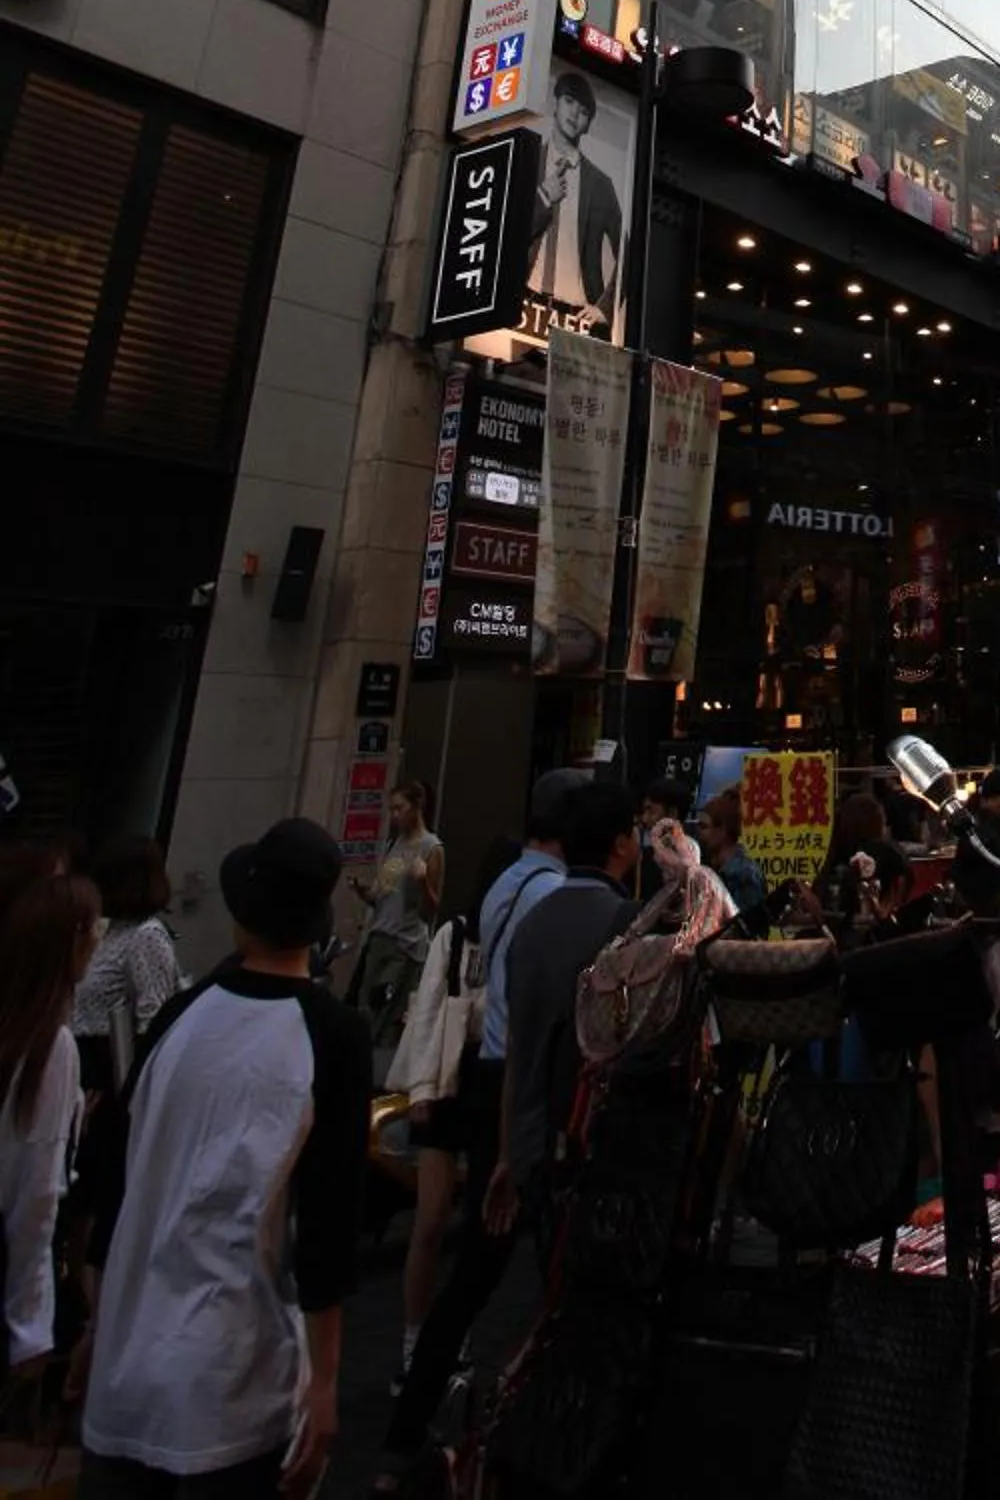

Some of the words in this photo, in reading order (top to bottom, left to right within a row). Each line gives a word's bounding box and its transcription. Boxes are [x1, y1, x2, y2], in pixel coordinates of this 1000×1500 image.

[474, 10, 529, 40] EXCHANGE
[456, 164, 495, 290] STAFF
[477, 416, 522, 444] HOTEL
[468, 534, 532, 567] STAFF
